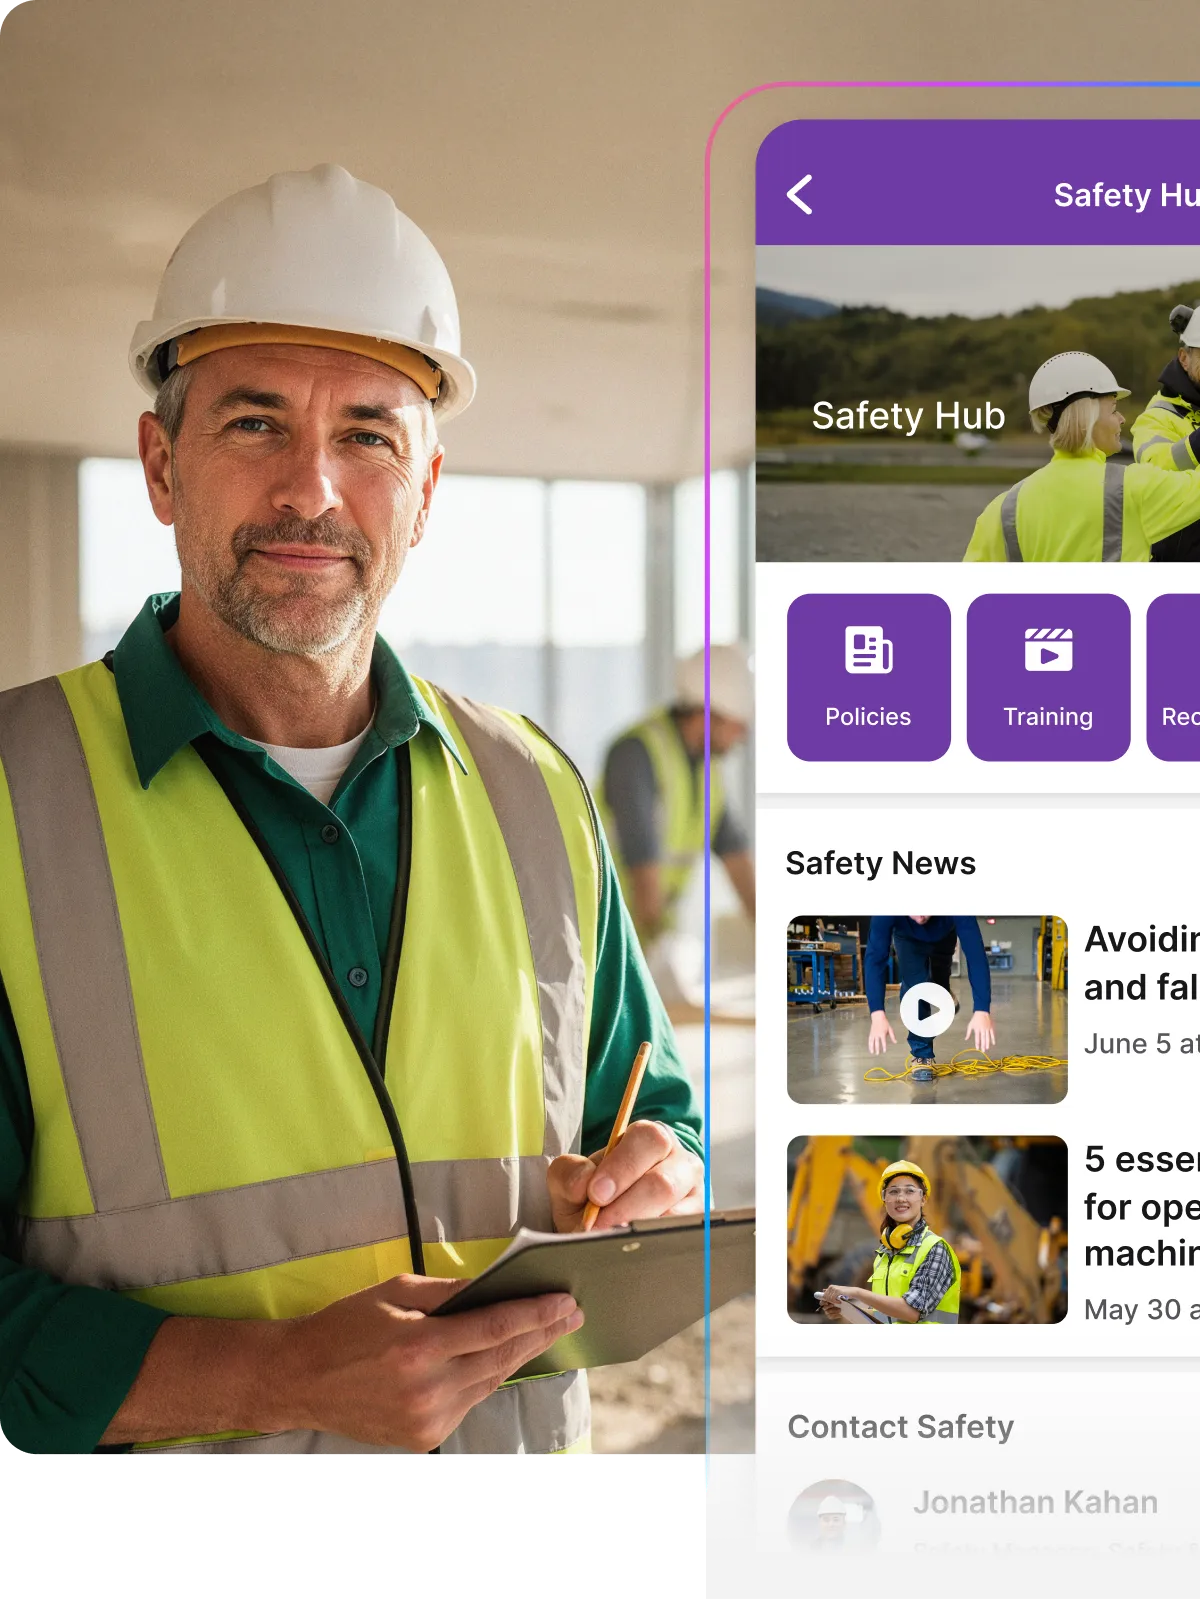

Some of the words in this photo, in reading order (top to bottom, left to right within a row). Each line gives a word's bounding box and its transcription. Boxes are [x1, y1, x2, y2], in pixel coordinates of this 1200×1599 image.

[1054, 181, 1152, 214] Safety
[812, 400, 924, 437] Safety
[936, 401, 1005, 430] Hub
[826, 706, 912, 726] Policies
[1003, 706, 1093, 731] Training
[786, 849, 884, 882] Safety
[892, 850, 977, 876] News
[1084, 973, 1146, 1001] and
[1084, 1032, 1148, 1055] June
[1156, 1032, 1172, 1055] 5
[1085, 1145, 1105, 1173] 5
[1083, 1191, 1132, 1221] for
[1085, 1298, 1139, 1326] May
[1147, 1298, 1181, 1321] 30
[788, 1413, 909, 1439] Contact
[917, 1413, 1015, 1445] Safety
[913, 1489, 1055, 1515] Jonathan
[1064, 1489, 1158, 1515] Kahan
